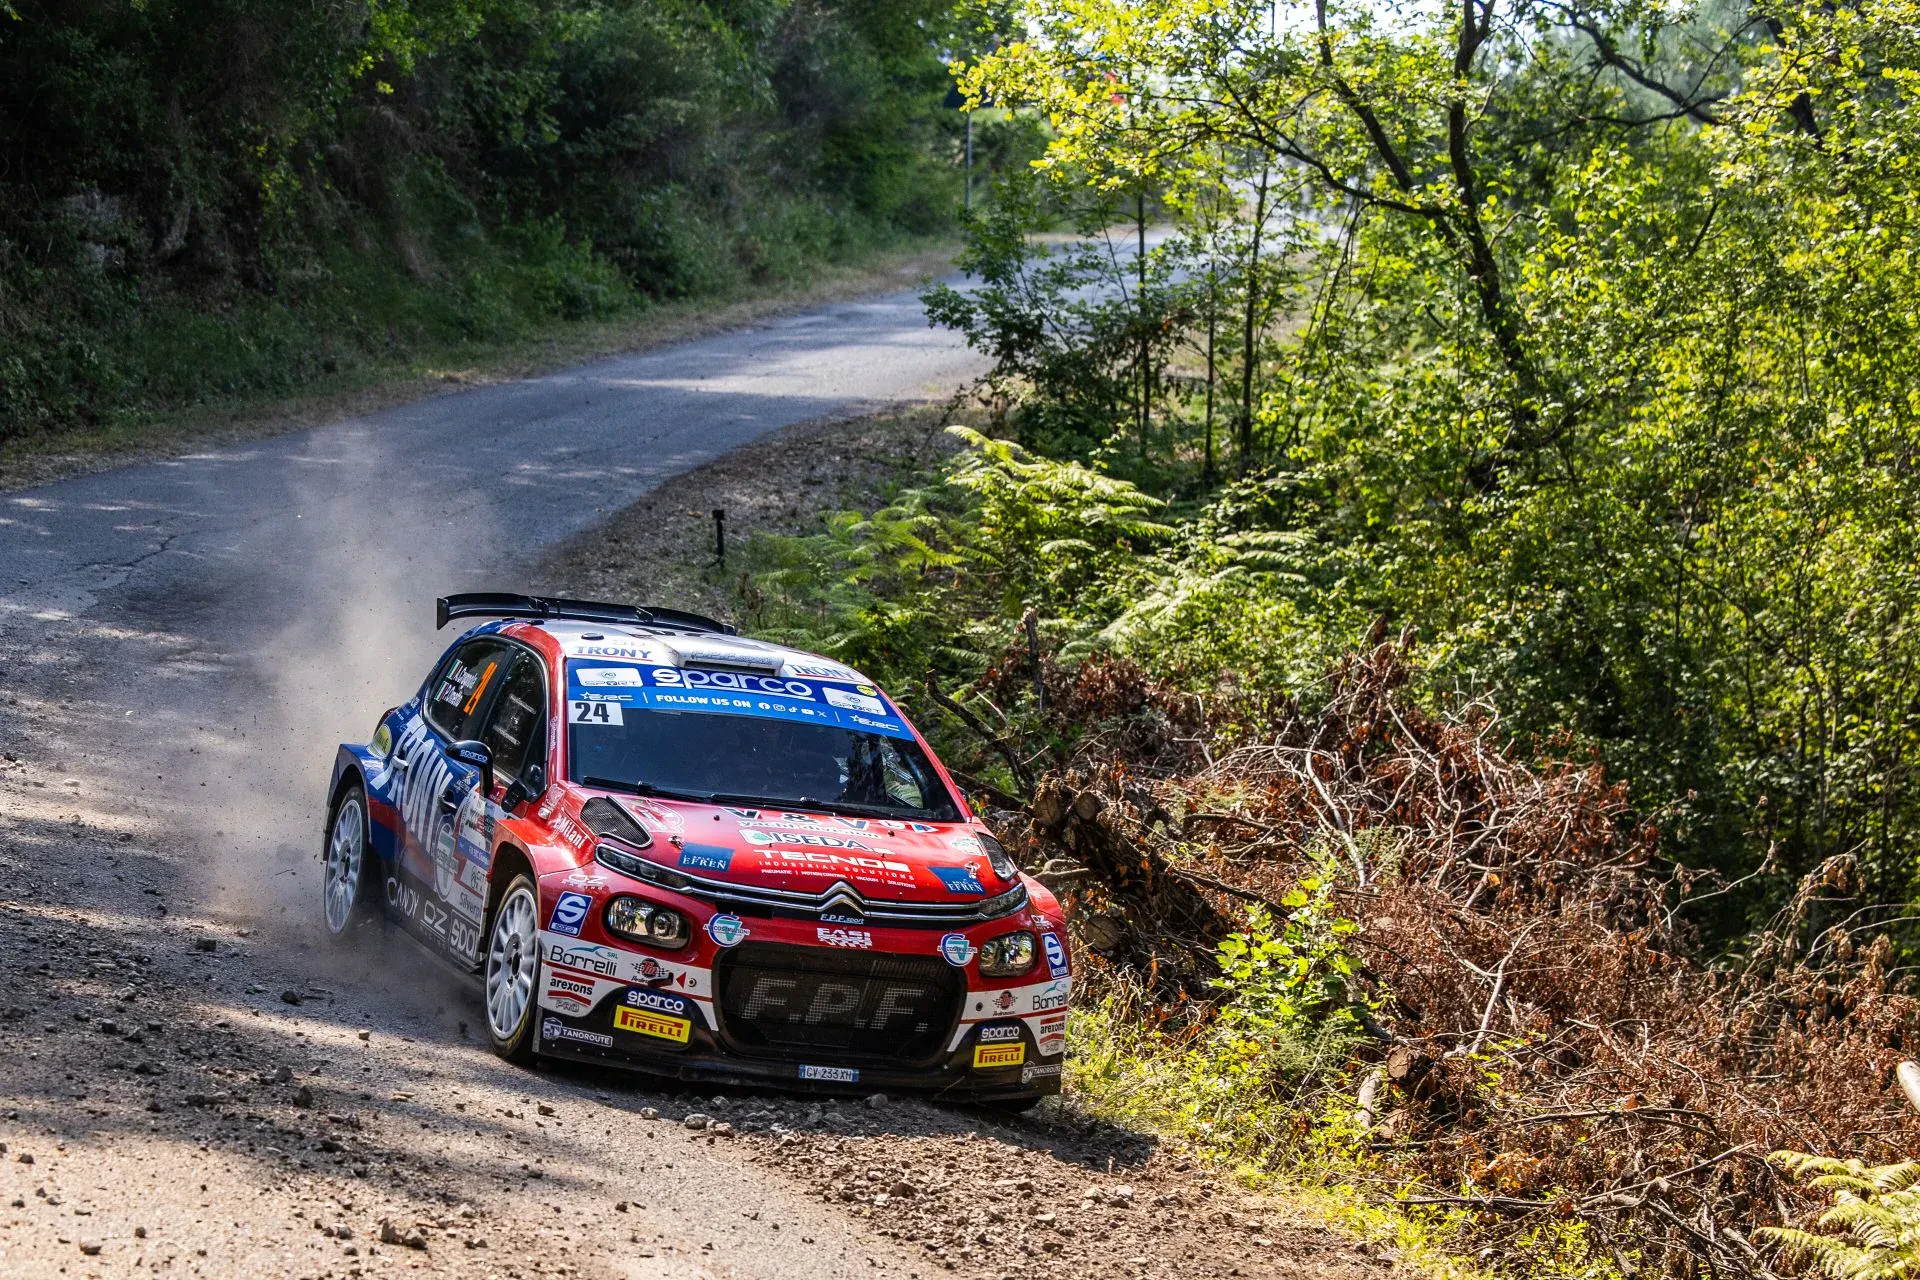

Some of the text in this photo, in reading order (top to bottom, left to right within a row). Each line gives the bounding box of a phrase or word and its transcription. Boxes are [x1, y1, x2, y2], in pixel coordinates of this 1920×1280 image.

[574, 646, 653, 659] TRONY
[786, 664, 855, 680] TRONY
[652, 668, 814, 699] sparco
[656, 694, 751, 708] FOLLOW US ON
[574, 702, 610, 723] 24
[461, 749, 487, 762] sparco
[682, 856, 727, 870] EFREN
[759, 860, 915, 881] INDUSTRIAL SOLUTIONS
[568, 873, 608, 885] OZ
[856, 875, 879, 883] VACUUM
[887, 879, 917, 888] SOLUTIONS
[424, 900, 447, 935] OZ
[550, 945, 617, 976] Borrelli
[550, 977, 593, 996] arexons
[627, 990, 685, 1012] sparco
[1032, 992, 1067, 1011] Borrelli
[620, 1010, 684, 1038] PIRELLI
[1039, 1022, 1065, 1035] arexons
[562, 1028, 611, 1045] TANOROUTE
[981, 1026, 1020, 1041] sparco
[978, 1047, 1021, 1064] PIRELLI
